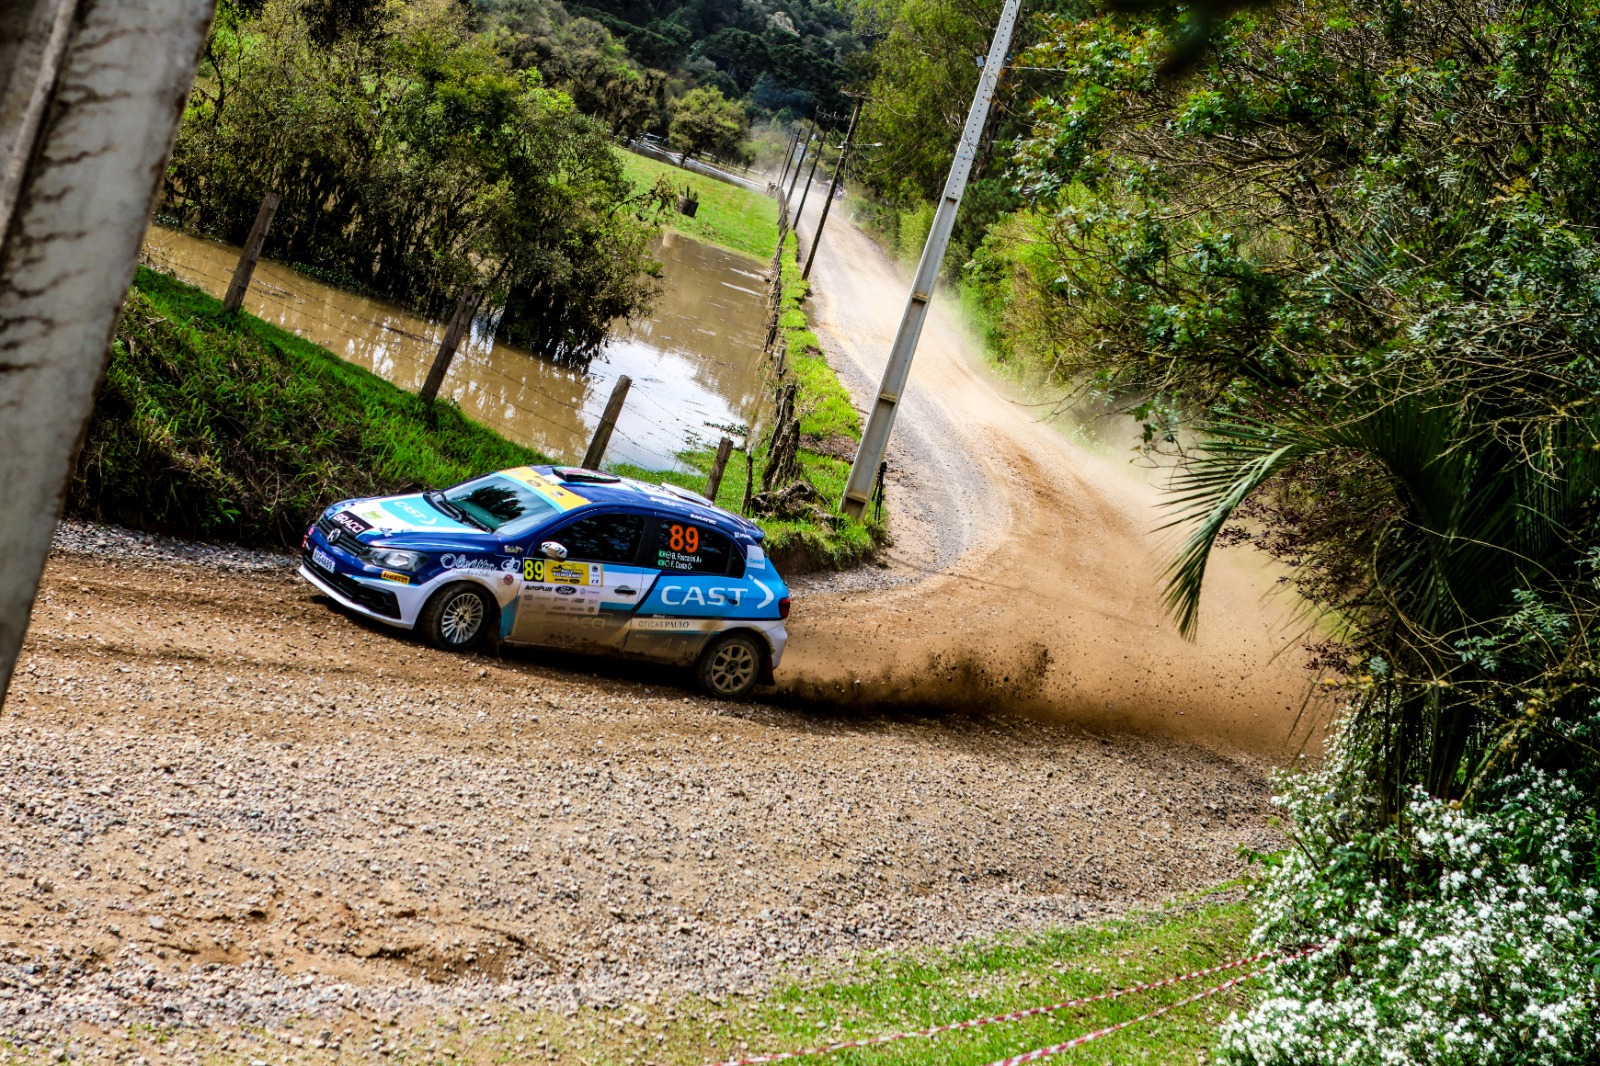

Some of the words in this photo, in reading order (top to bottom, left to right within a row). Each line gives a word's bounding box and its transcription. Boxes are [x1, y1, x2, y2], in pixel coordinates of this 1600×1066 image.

[394, 501, 427, 520] CAST
[669, 524, 699, 553] 89
[524, 560, 544, 580] 89
[661, 585, 748, 606] CAST
[638, 620, 664, 628] ÓTICAS
